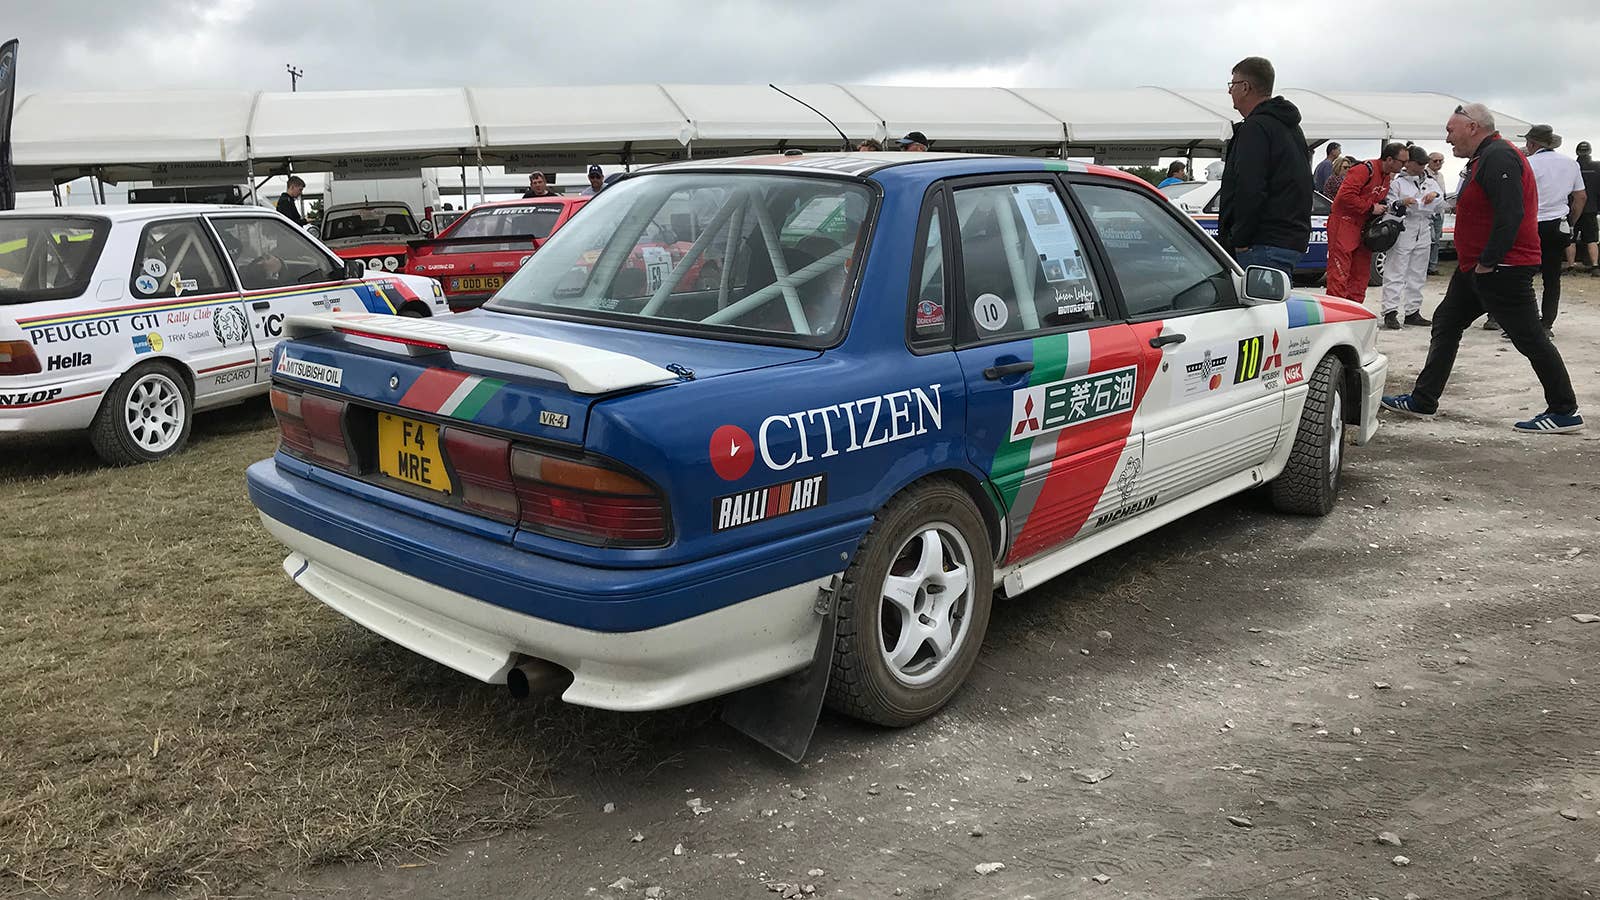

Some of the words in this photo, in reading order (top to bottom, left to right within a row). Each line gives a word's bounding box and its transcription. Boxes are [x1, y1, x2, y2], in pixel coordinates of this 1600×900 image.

[493, 206, 536, 215] PIRELLI
[150, 263, 160, 273] 49
[484, 277, 500, 288] 169
[167, 311, 190, 327] Rally
[193, 308, 212, 321] Club
[983, 302, 999, 322] 10
[1058, 301, 1095, 315] MOTORSPORT
[30, 319, 120, 345] PEUGEOT
[130, 313, 160, 331] GTI
[168, 333, 186, 343] TRW
[47, 352, 92, 371] Hella
[1240, 337, 1259, 382] 10
[215, 370, 250, 385] RECARO
[287, 360, 325, 381] MITSUBISHI
[326, 369, 339, 384] OIL
[1286, 366, 1302, 381] NGK
[1045, 372, 1133, 425] 三菱石油
[541, 411, 565, 427] VR-4
[758, 383, 942, 471] CITIZEN
[403, 421, 425, 451] F4
[398, 450, 432, 484] MRE
[1095, 495, 1158, 528] MICHELIN
